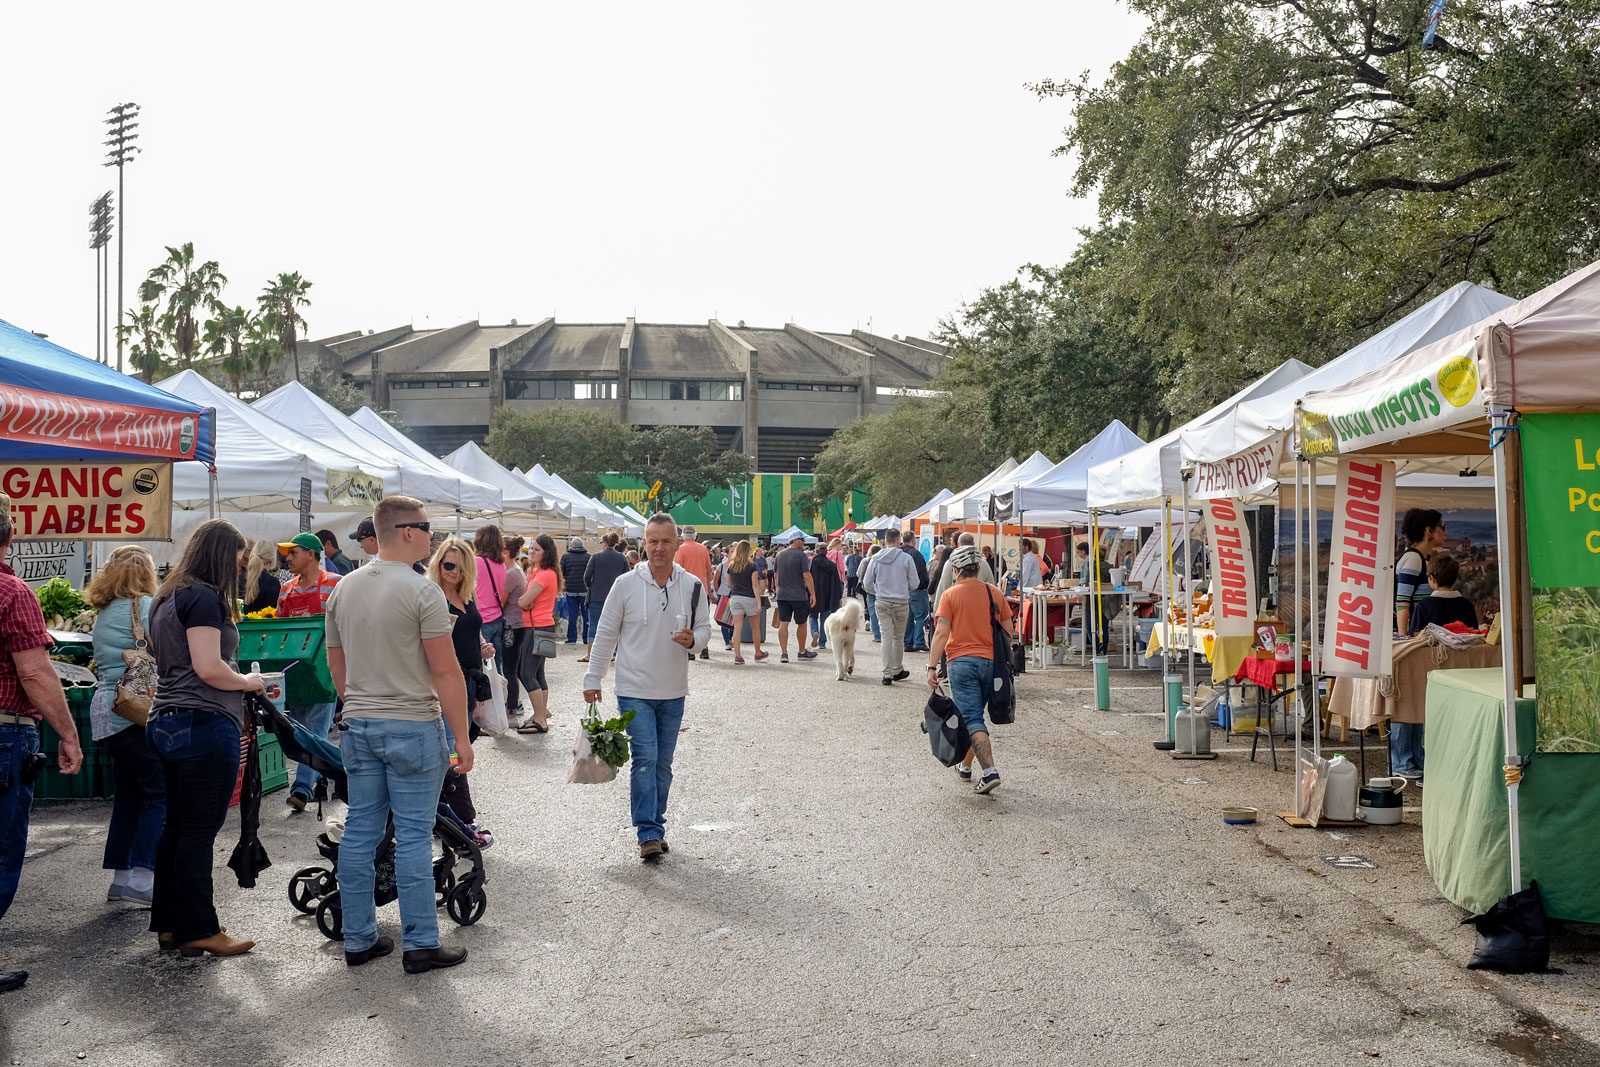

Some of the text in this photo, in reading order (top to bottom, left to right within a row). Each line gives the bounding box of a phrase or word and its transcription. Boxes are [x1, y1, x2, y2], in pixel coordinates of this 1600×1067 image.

[114, 411, 174, 451] FARM
[1575, 438, 1600, 470] L
[2, 467, 123, 498] GANIC
[1195, 462, 1234, 493] FRESH
[10, 555, 67, 579] CHEESE
[1209, 497, 1248, 619] TRUFFLE OI
[1335, 461, 1382, 671] TRUFFLE SALT
